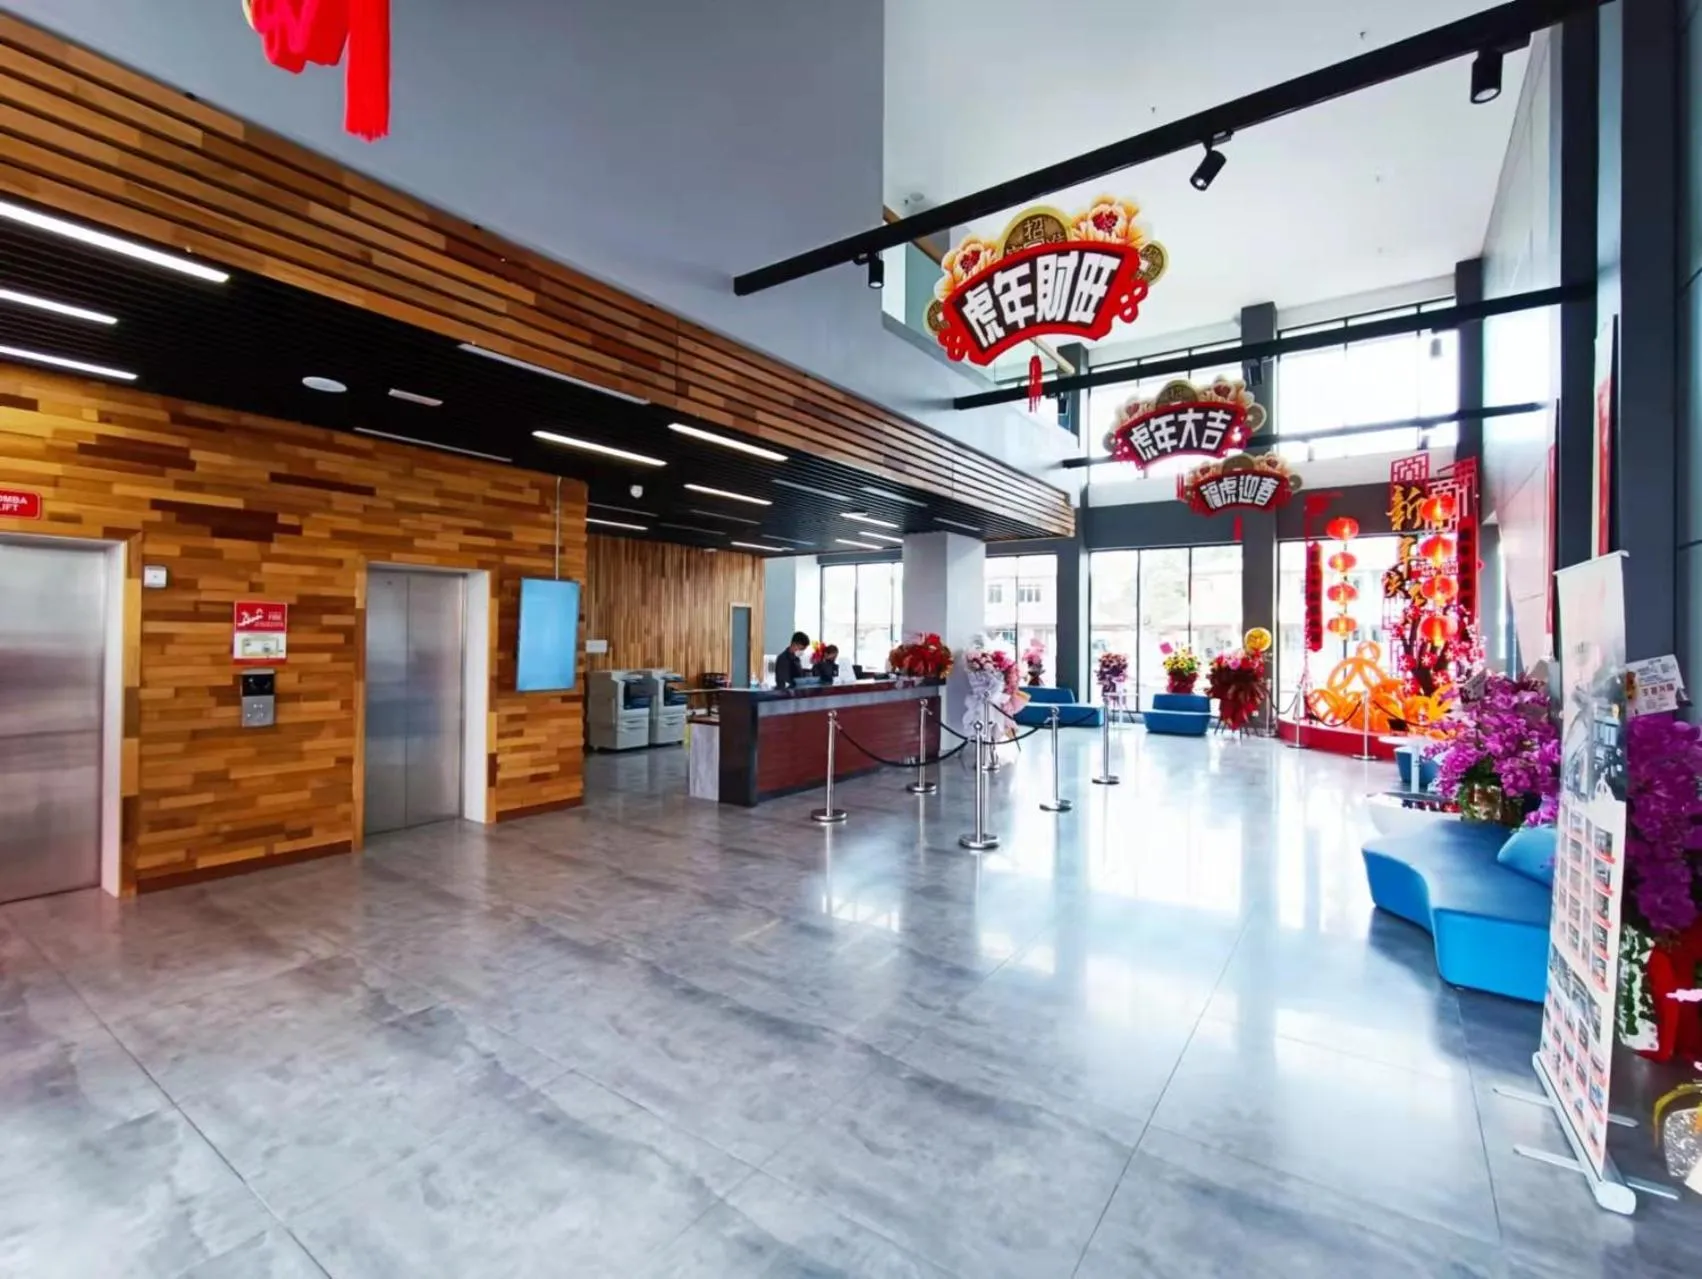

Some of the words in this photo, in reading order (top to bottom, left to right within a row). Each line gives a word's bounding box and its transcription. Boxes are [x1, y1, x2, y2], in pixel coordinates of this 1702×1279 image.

[1129, 408, 1232, 461] 虎年大吉
[0, 503, 18, 511] IFT
[1200, 474, 1280, 510] 福虎迎春
